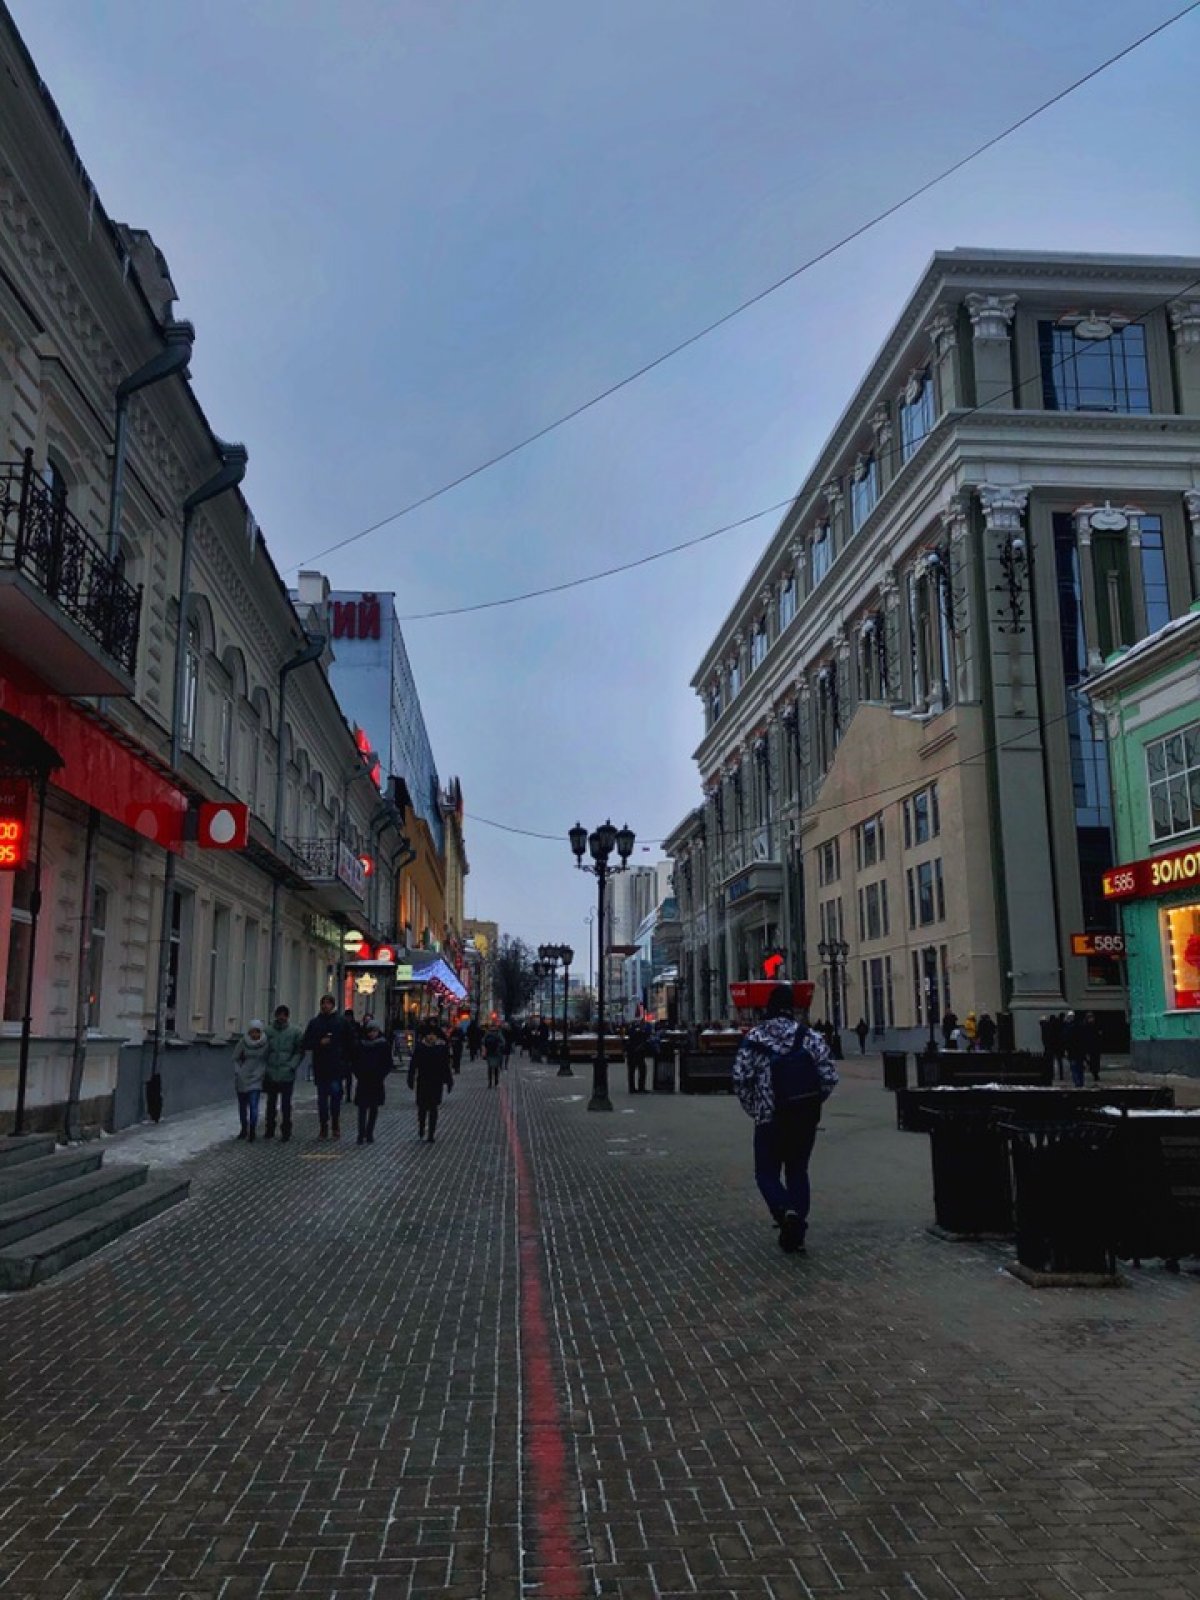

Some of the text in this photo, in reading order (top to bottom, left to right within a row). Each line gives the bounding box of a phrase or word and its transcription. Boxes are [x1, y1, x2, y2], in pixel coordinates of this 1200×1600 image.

[328, 591, 380, 640] ИЙ
[1114, 872, 1135, 893] 585
[1094, 935, 1124, 951] 585
